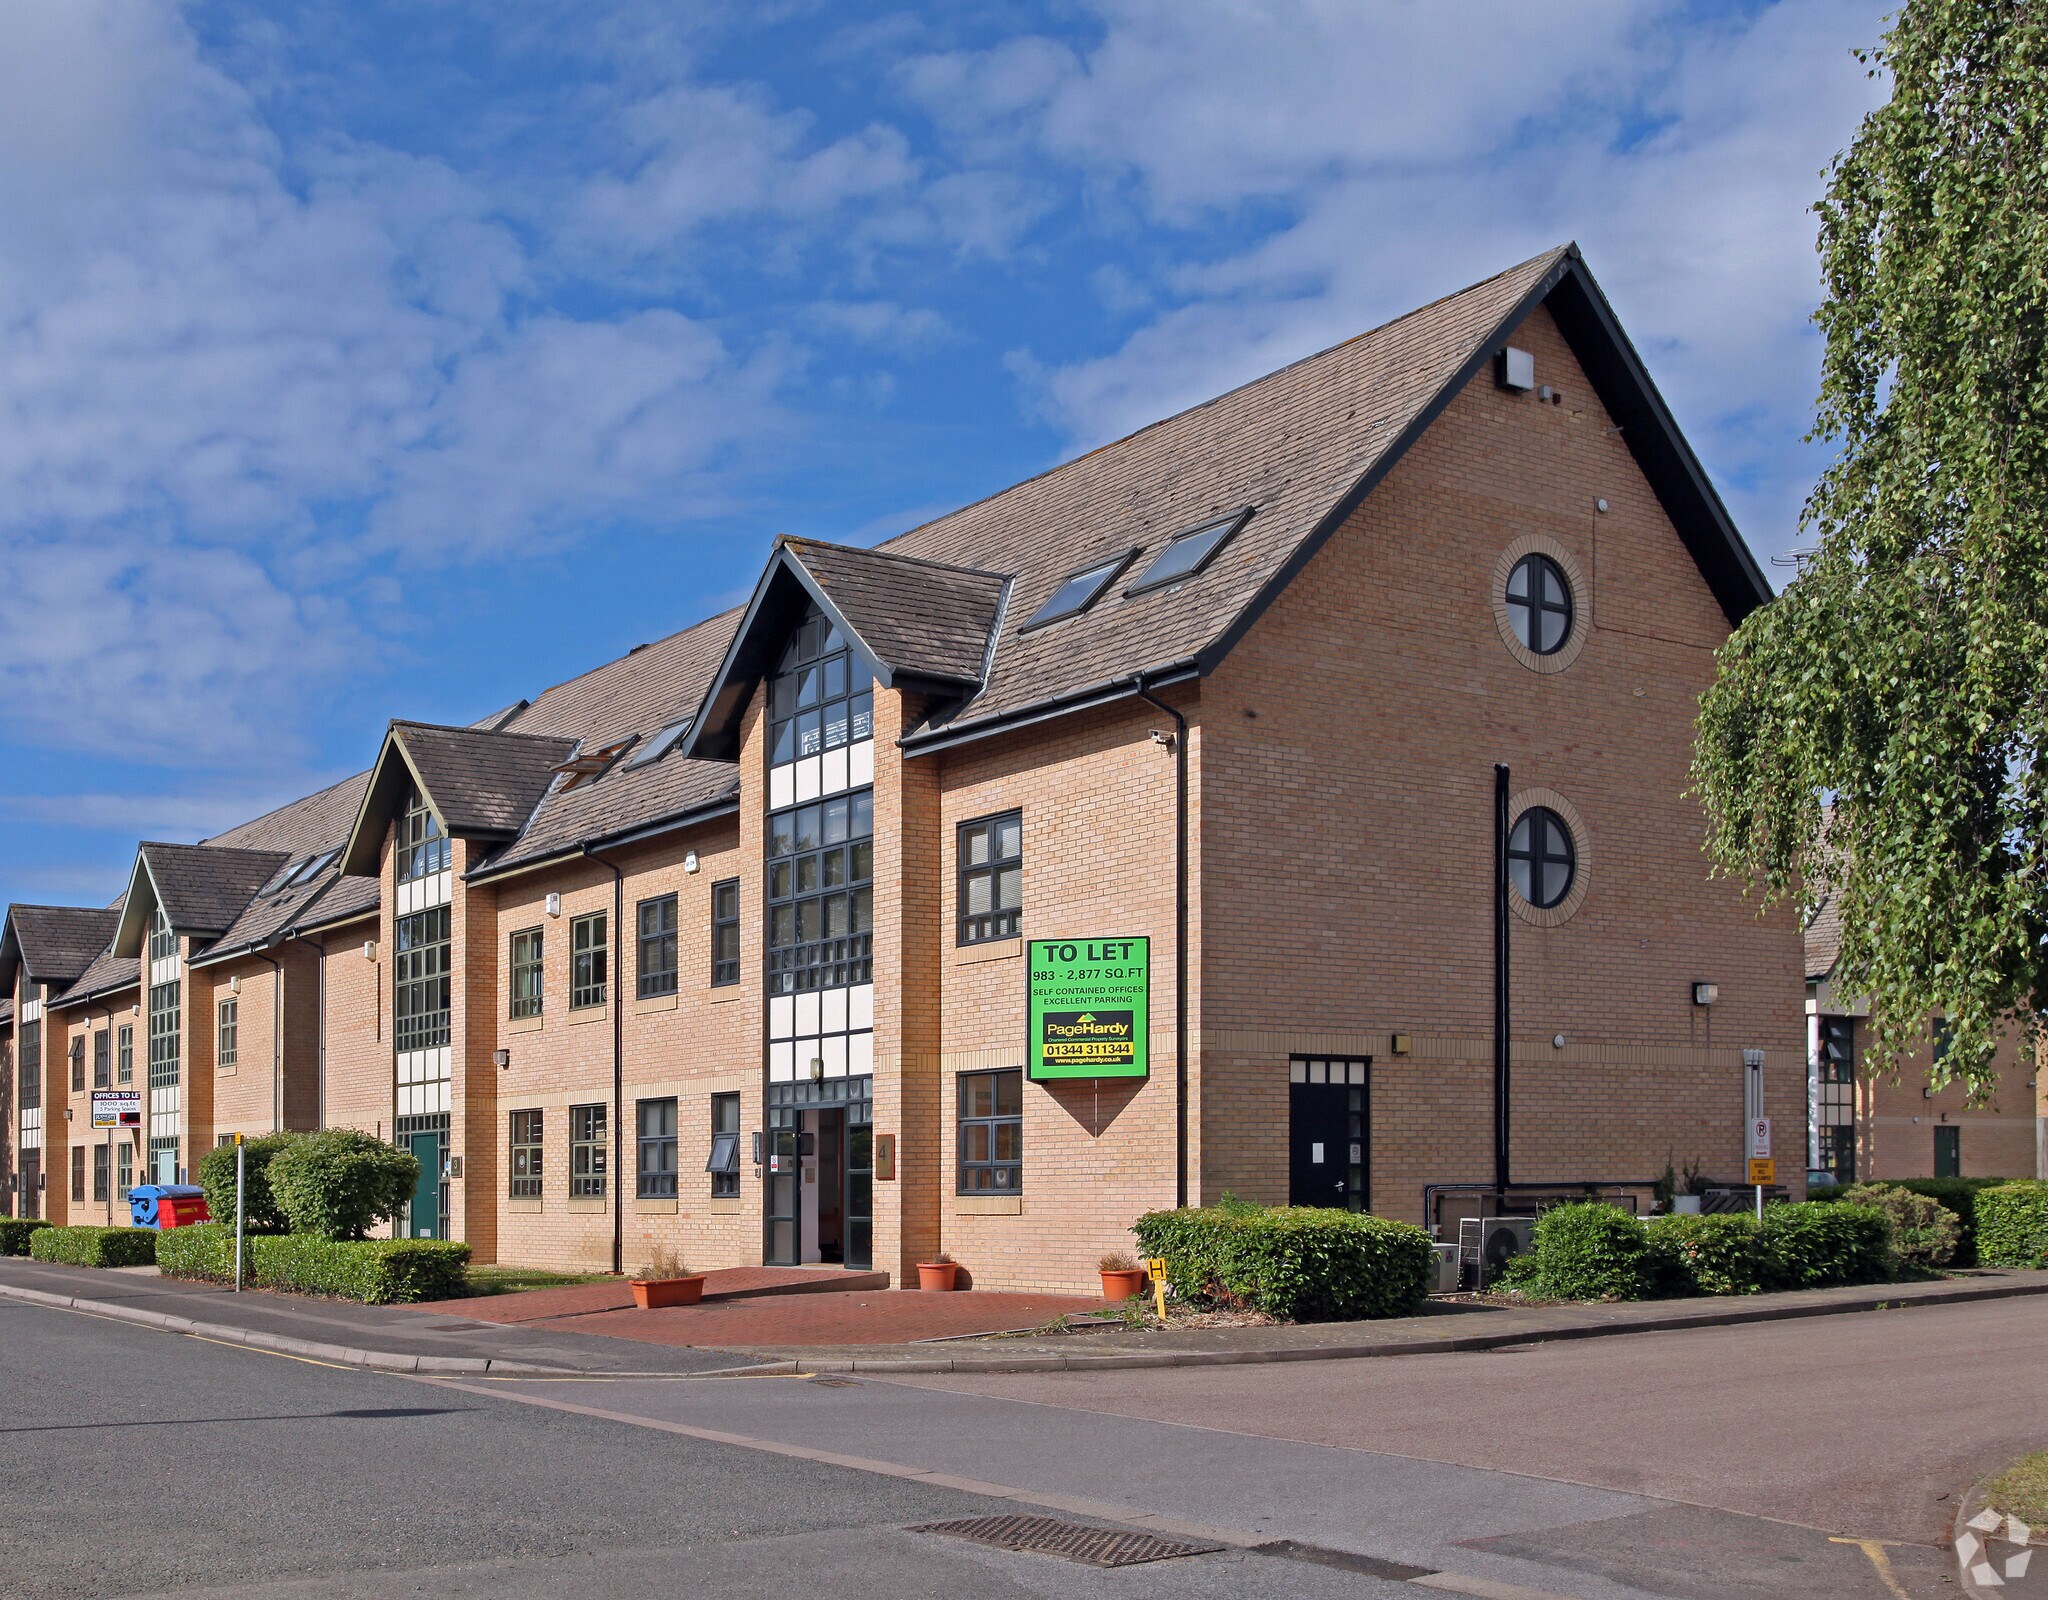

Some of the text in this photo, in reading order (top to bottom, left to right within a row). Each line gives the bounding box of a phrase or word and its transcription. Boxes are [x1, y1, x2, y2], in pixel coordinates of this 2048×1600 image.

[1043, 943, 1134, 962] TO LET
[1033, 971, 1055, 981] 983
[1067, 969, 1101, 981] 2,877
[1104, 968, 1144, 979] SQ.FT
[1033, 985, 1144, 996] SELF CONTAINED OFFICES
[1043, 996, 1133, 1006] EXCELLENT PARKING
[1047, 1022, 1129, 1037] PageHardy
[1047, 1044, 1130, 1055] 01344 311344
[1055, 1056, 1121, 1064] www.pagehardy.co.uk
[878, 1144, 886, 1161] 4
[1149, 1260, 1164, 1279] H
